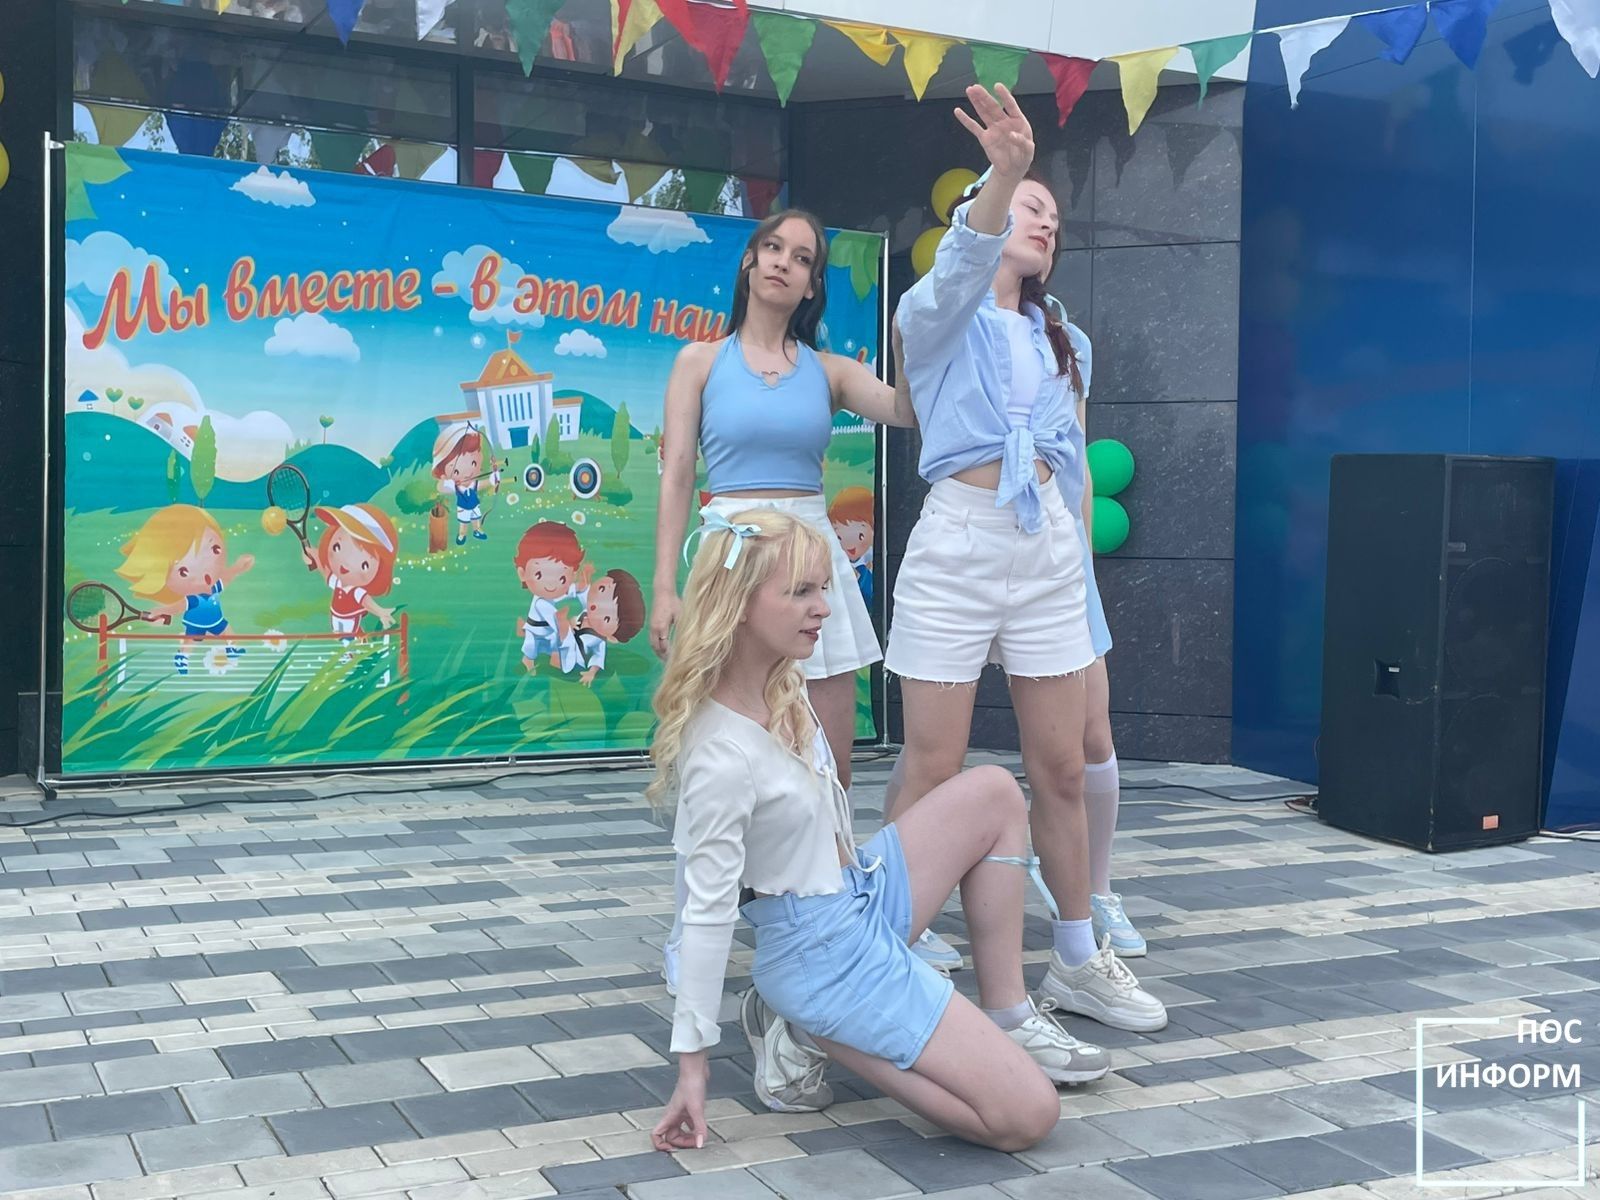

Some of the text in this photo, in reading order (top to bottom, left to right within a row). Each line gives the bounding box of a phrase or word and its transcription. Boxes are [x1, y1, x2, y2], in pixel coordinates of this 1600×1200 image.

[82, 260, 209, 350] Мы
[223, 255, 422, 322] вместе
[469, 252, 501, 312] в
[513, 273, 640, 329] этом
